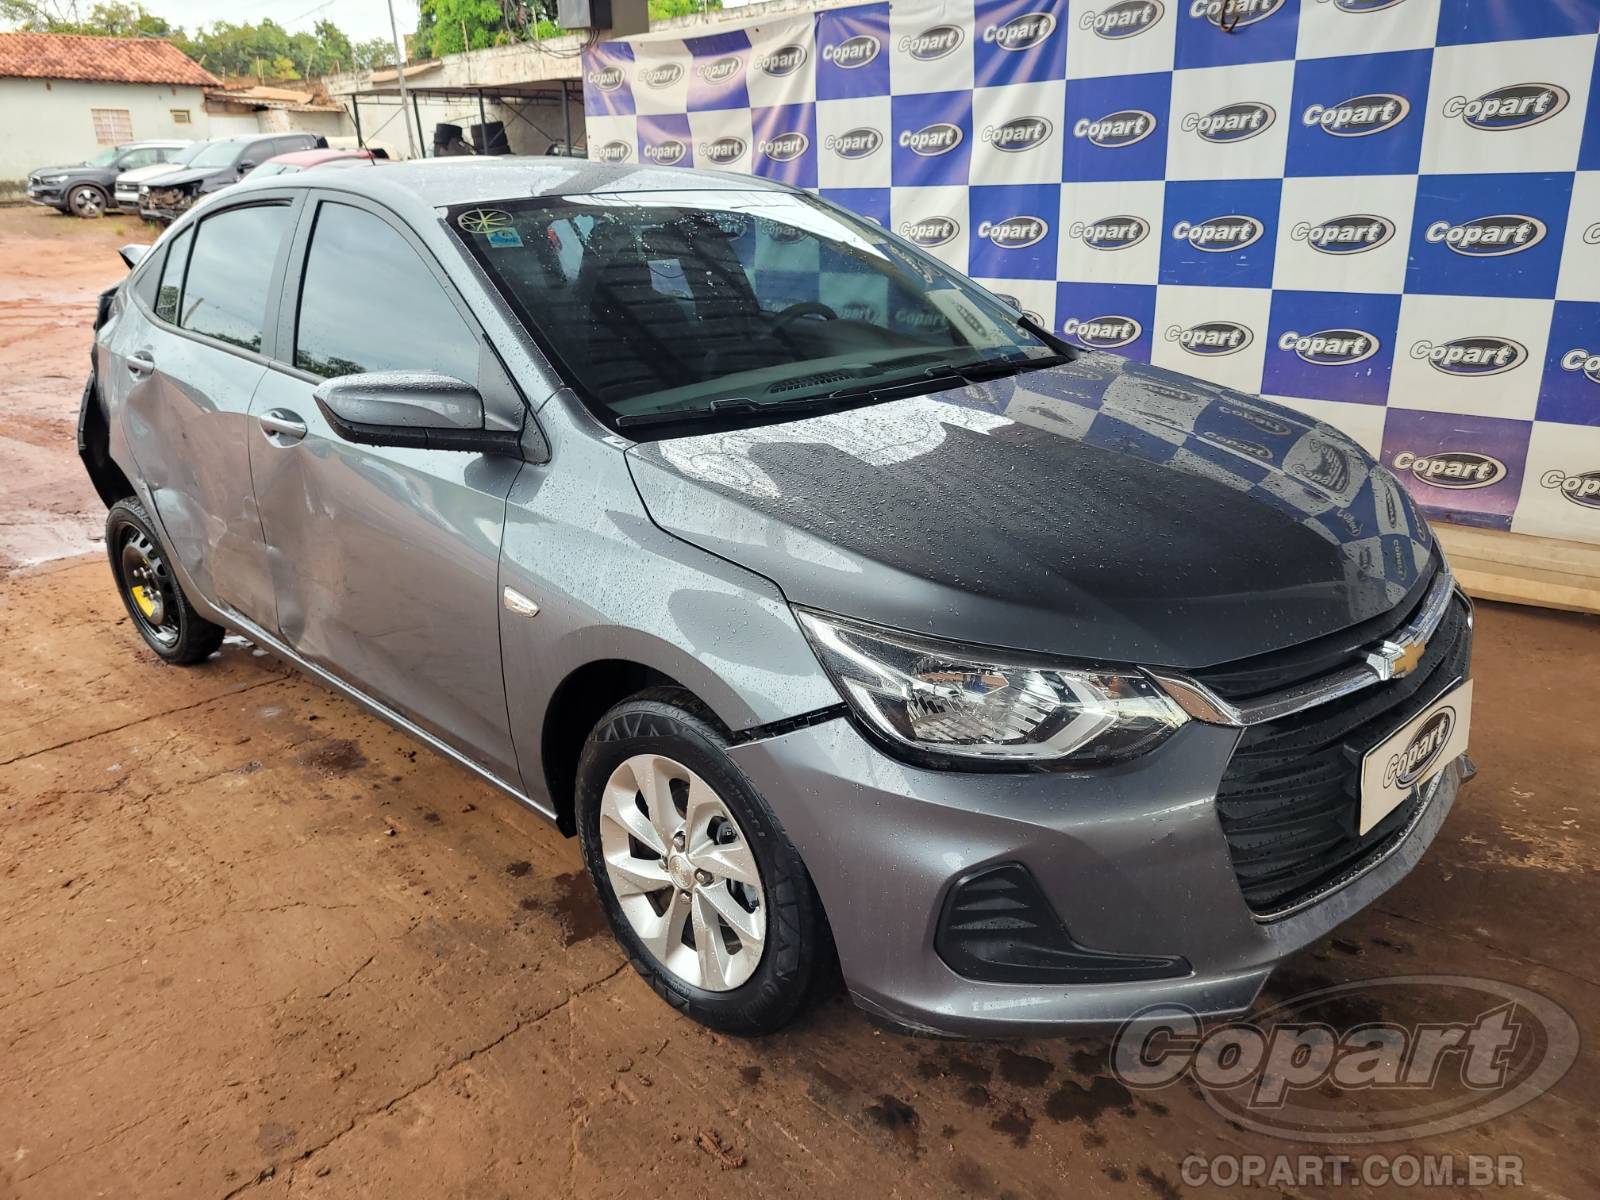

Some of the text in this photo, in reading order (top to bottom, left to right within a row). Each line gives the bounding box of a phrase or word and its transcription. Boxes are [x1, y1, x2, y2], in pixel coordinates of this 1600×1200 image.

[983, 19, 1048, 44] Copart
[1079, 5, 1150, 34] Copart
[823, 40, 872, 64] Copart
[899, 30, 955, 53] Copart
[697, 59, 738, 77] Copart
[754, 49, 801, 74] Copart
[588, 71, 620, 84] Copart
[640, 67, 677, 83] Copart
[1303, 101, 1395, 128] Copart
[1443, 91, 1553, 122] Copart
[982, 121, 1043, 146] Copart
[1074, 114, 1145, 141] Copart
[1181, 110, 1262, 136] Copart
[644, 143, 681, 160] Copart
[700, 141, 741, 161] Copart
[758, 138, 801, 159] Copart
[825, 132, 874, 155] Copart
[899, 127, 954, 152] Copart
[900, 219, 951, 241] Copart
[978, 219, 1039, 243] Copart
[1069, 219, 1141, 245] Copart
[1173, 219, 1252, 243] Copart
[1291, 219, 1381, 245] Copart
[1425, 219, 1532, 248] Copart
[1063, 318, 1134, 341] Copart
[1165, 324, 1242, 349] Copart
[1277, 331, 1367, 356] Copart
[1410, 340, 1514, 367] Copart
[1393, 451, 1493, 481] Copart
[1383, 713, 1447, 789] Copart
